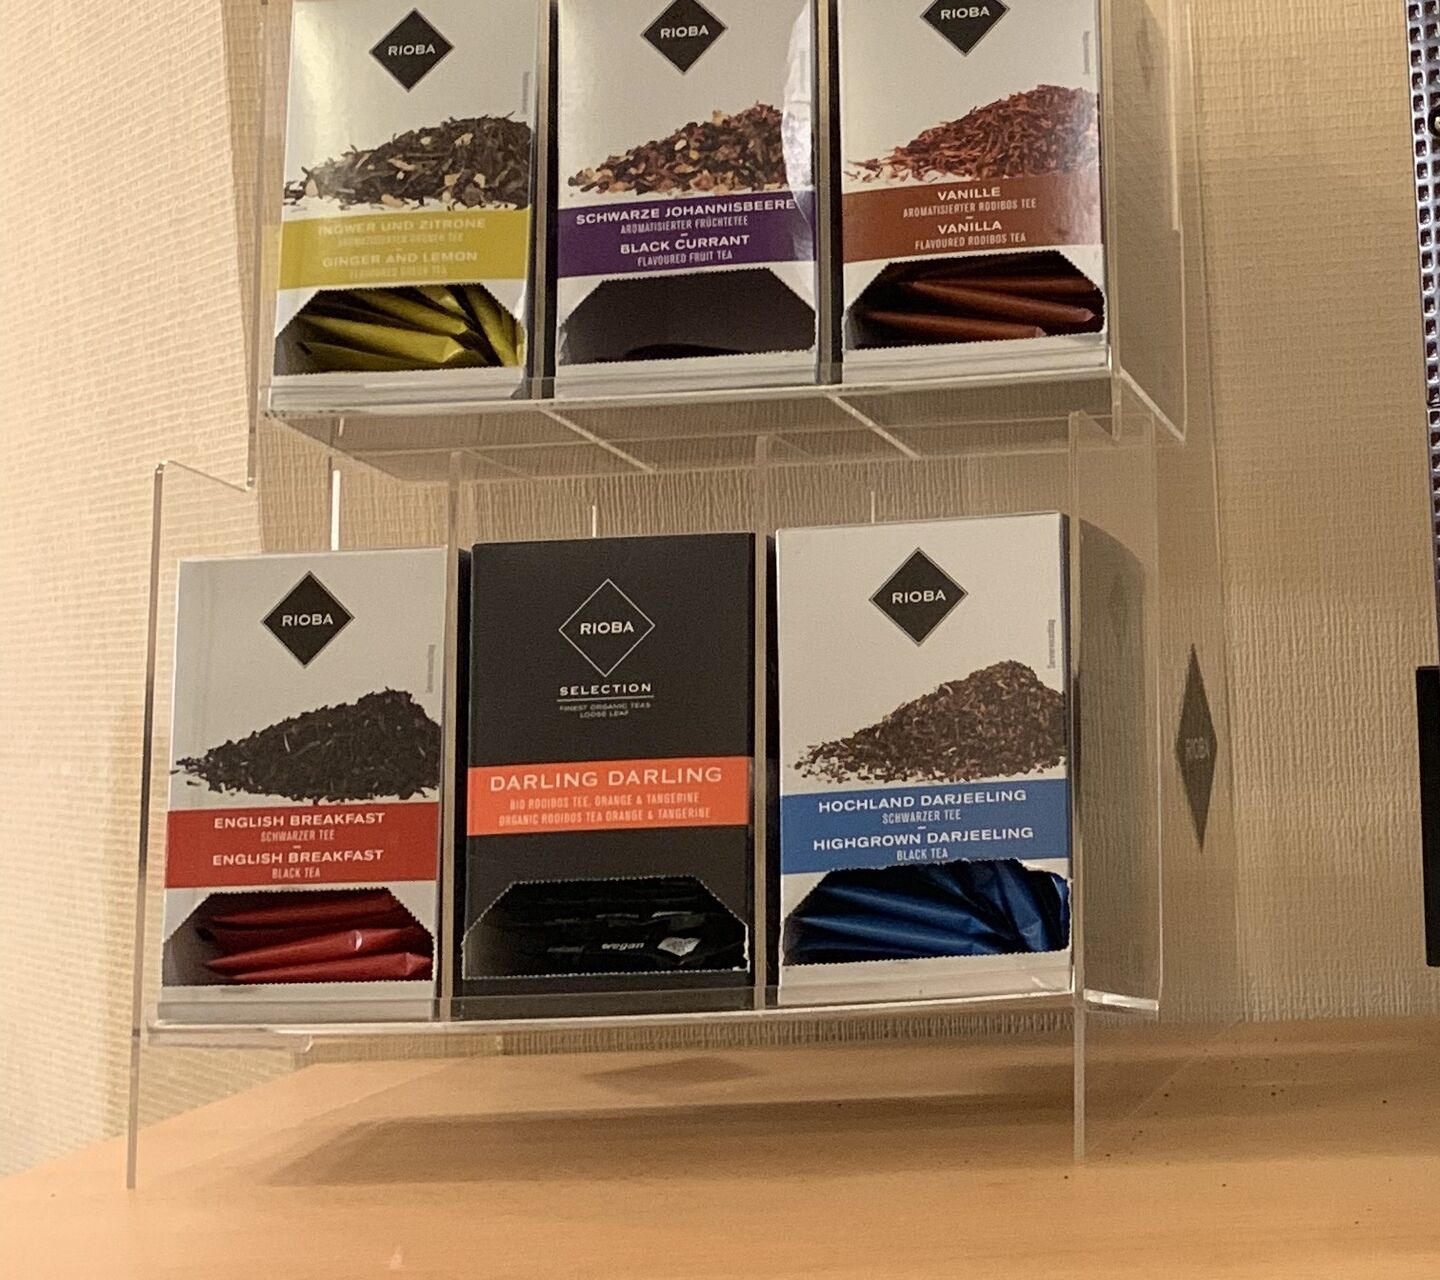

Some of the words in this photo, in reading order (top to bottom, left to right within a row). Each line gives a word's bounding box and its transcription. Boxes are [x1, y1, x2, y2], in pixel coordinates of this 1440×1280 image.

[940, 6, 990, 20] RIOBA
[660, 24, 709, 39] RIOBA
[388, 43, 436, 56] RIOBA
[937, 187, 1001, 201] VANILLE
[576, 208, 660, 225] SCHWARZE
[665, 199, 796, 218] JOHANNISBEERE
[903, 202, 976, 218] AROMATISIERTER
[1021, 198, 1037, 209] TEE
[318, 221, 376, 236] INGWER
[381, 220, 414, 233] UND
[419, 218, 486, 230] ZITRONE
[621, 219, 692, 234] AROMATISIERTER
[937, 220, 1002, 234] VANILLA
[620, 241, 670, 254] BLACK
[675, 235, 750, 249] CURRANT
[914, 236, 965, 250] FLAVOURED
[1010, 232, 1026, 243] TEA
[323, 255, 380, 268] GINGER
[385, 252, 418, 264] AND
[423, 251, 478, 263] LEMON
[638, 253, 687, 267] FLAVOURED
[689, 251, 714, 263] FRUIT
[717, 249, 733, 260] TEA
[891, 589, 947, 604] RIOBA
[282, 613, 334, 627] RIOBA
[580, 621, 634, 635] RIOBA
[560, 683, 652, 696] SELECTION
[490, 771, 598, 792] DARLING
[608, 767, 722, 787] DARLING
[595, 793, 633, 806] ORANGE
[645, 792, 699, 805] TANGERINE
[818, 795, 915, 813] HOCHLAND
[920, 789, 1027, 807] DARJEELING
[214, 815, 284, 829] ENGLISH
[289, 812, 386, 827] BREAKFAST
[499, 814, 539, 827] ORGANIC
[585, 811, 602, 823] TEA
[606, 809, 643, 822] ORANGE
[657, 806, 711, 820] TANGERINE
[882, 811, 941, 825] SCHWARZER
[944, 809, 961, 820] TEE
[260, 829, 316, 842] SCHWARZER
[319, 829, 335, 840] TEE
[813, 833, 921, 851] HIGHGROWN
[927, 827, 1034, 844] DARJEELING
[212, 852, 283, 866] ENGLISH
[288, 849, 384, 865] BREAKFAST
[896, 848, 927, 861] BLACK
[930, 847, 948, 859] TEA
[272, 867, 301, 879] BLACK
[304, 867, 321, 878] TEA
